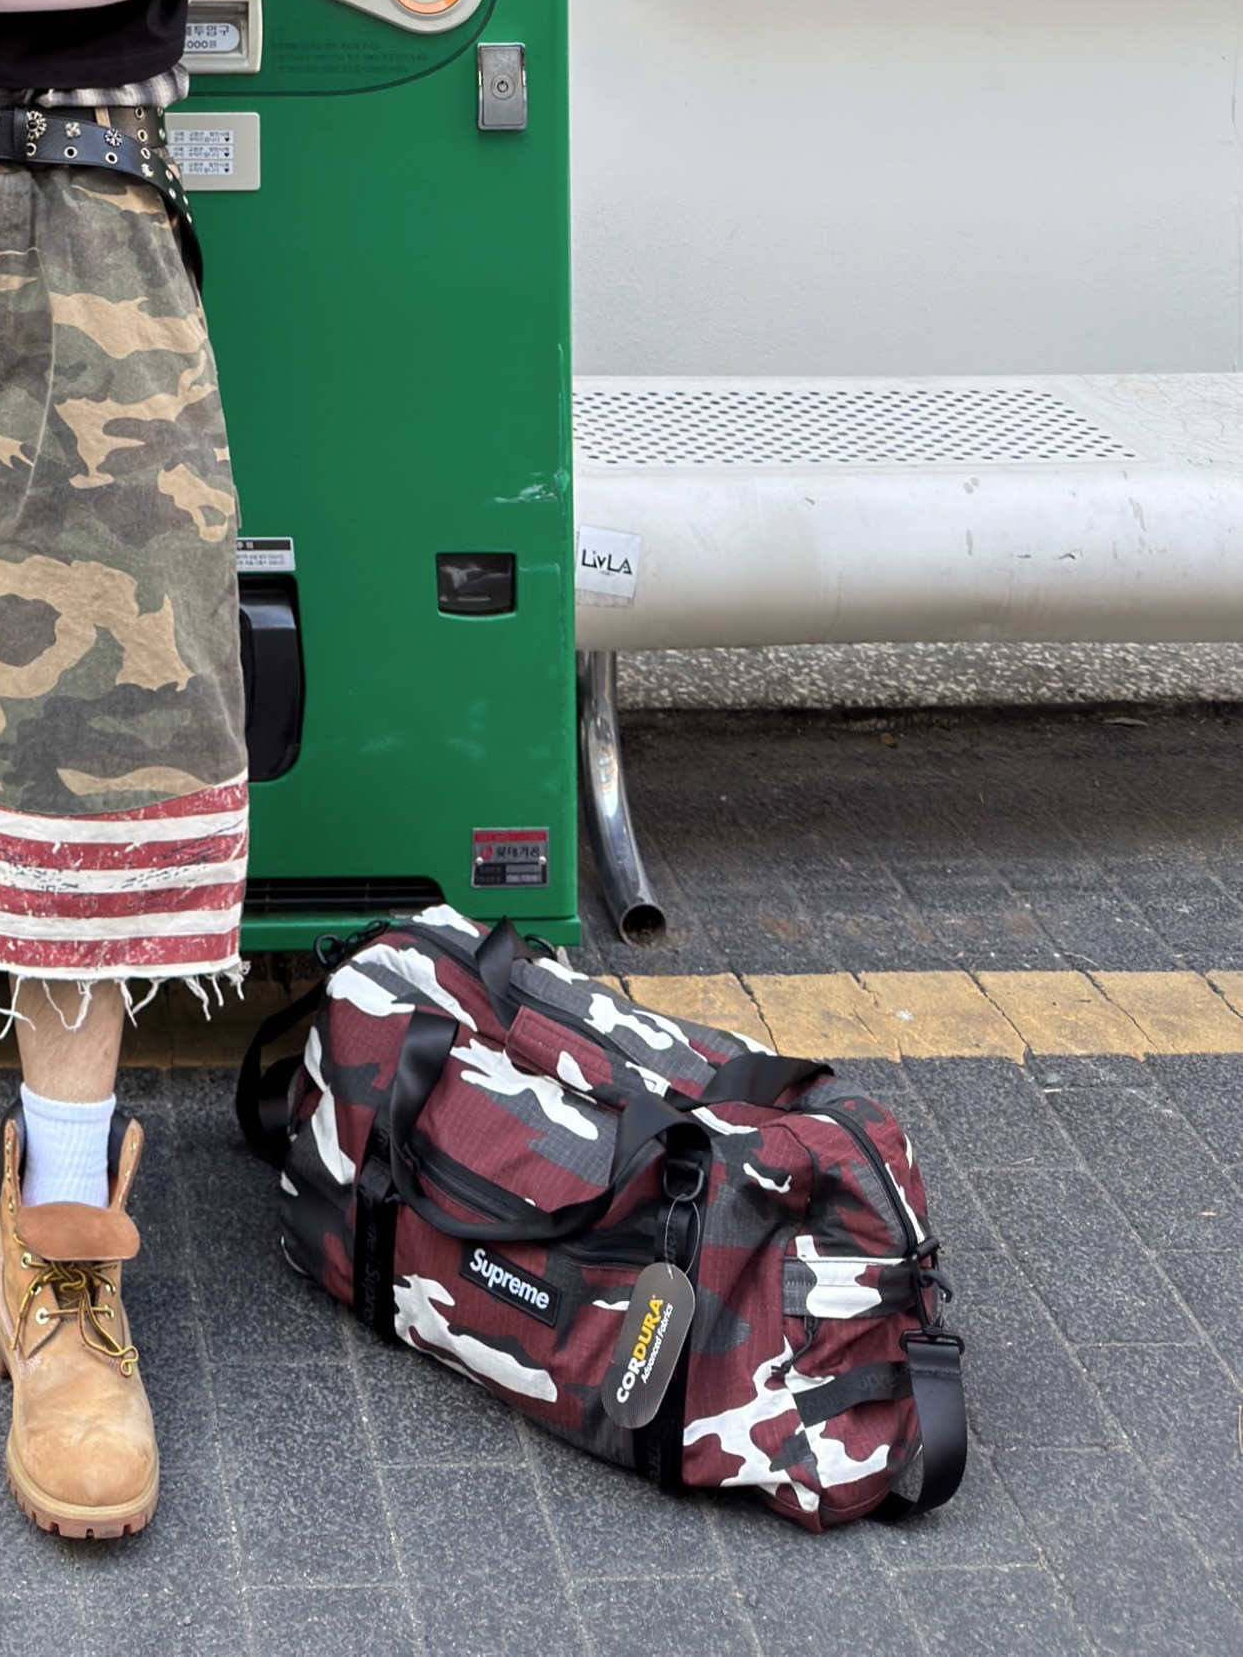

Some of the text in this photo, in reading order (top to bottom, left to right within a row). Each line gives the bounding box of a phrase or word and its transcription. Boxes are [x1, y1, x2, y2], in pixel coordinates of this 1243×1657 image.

[469, 1247, 551, 1311] Supreme
[639, 1303, 676, 1385] Advanced Fabrics
